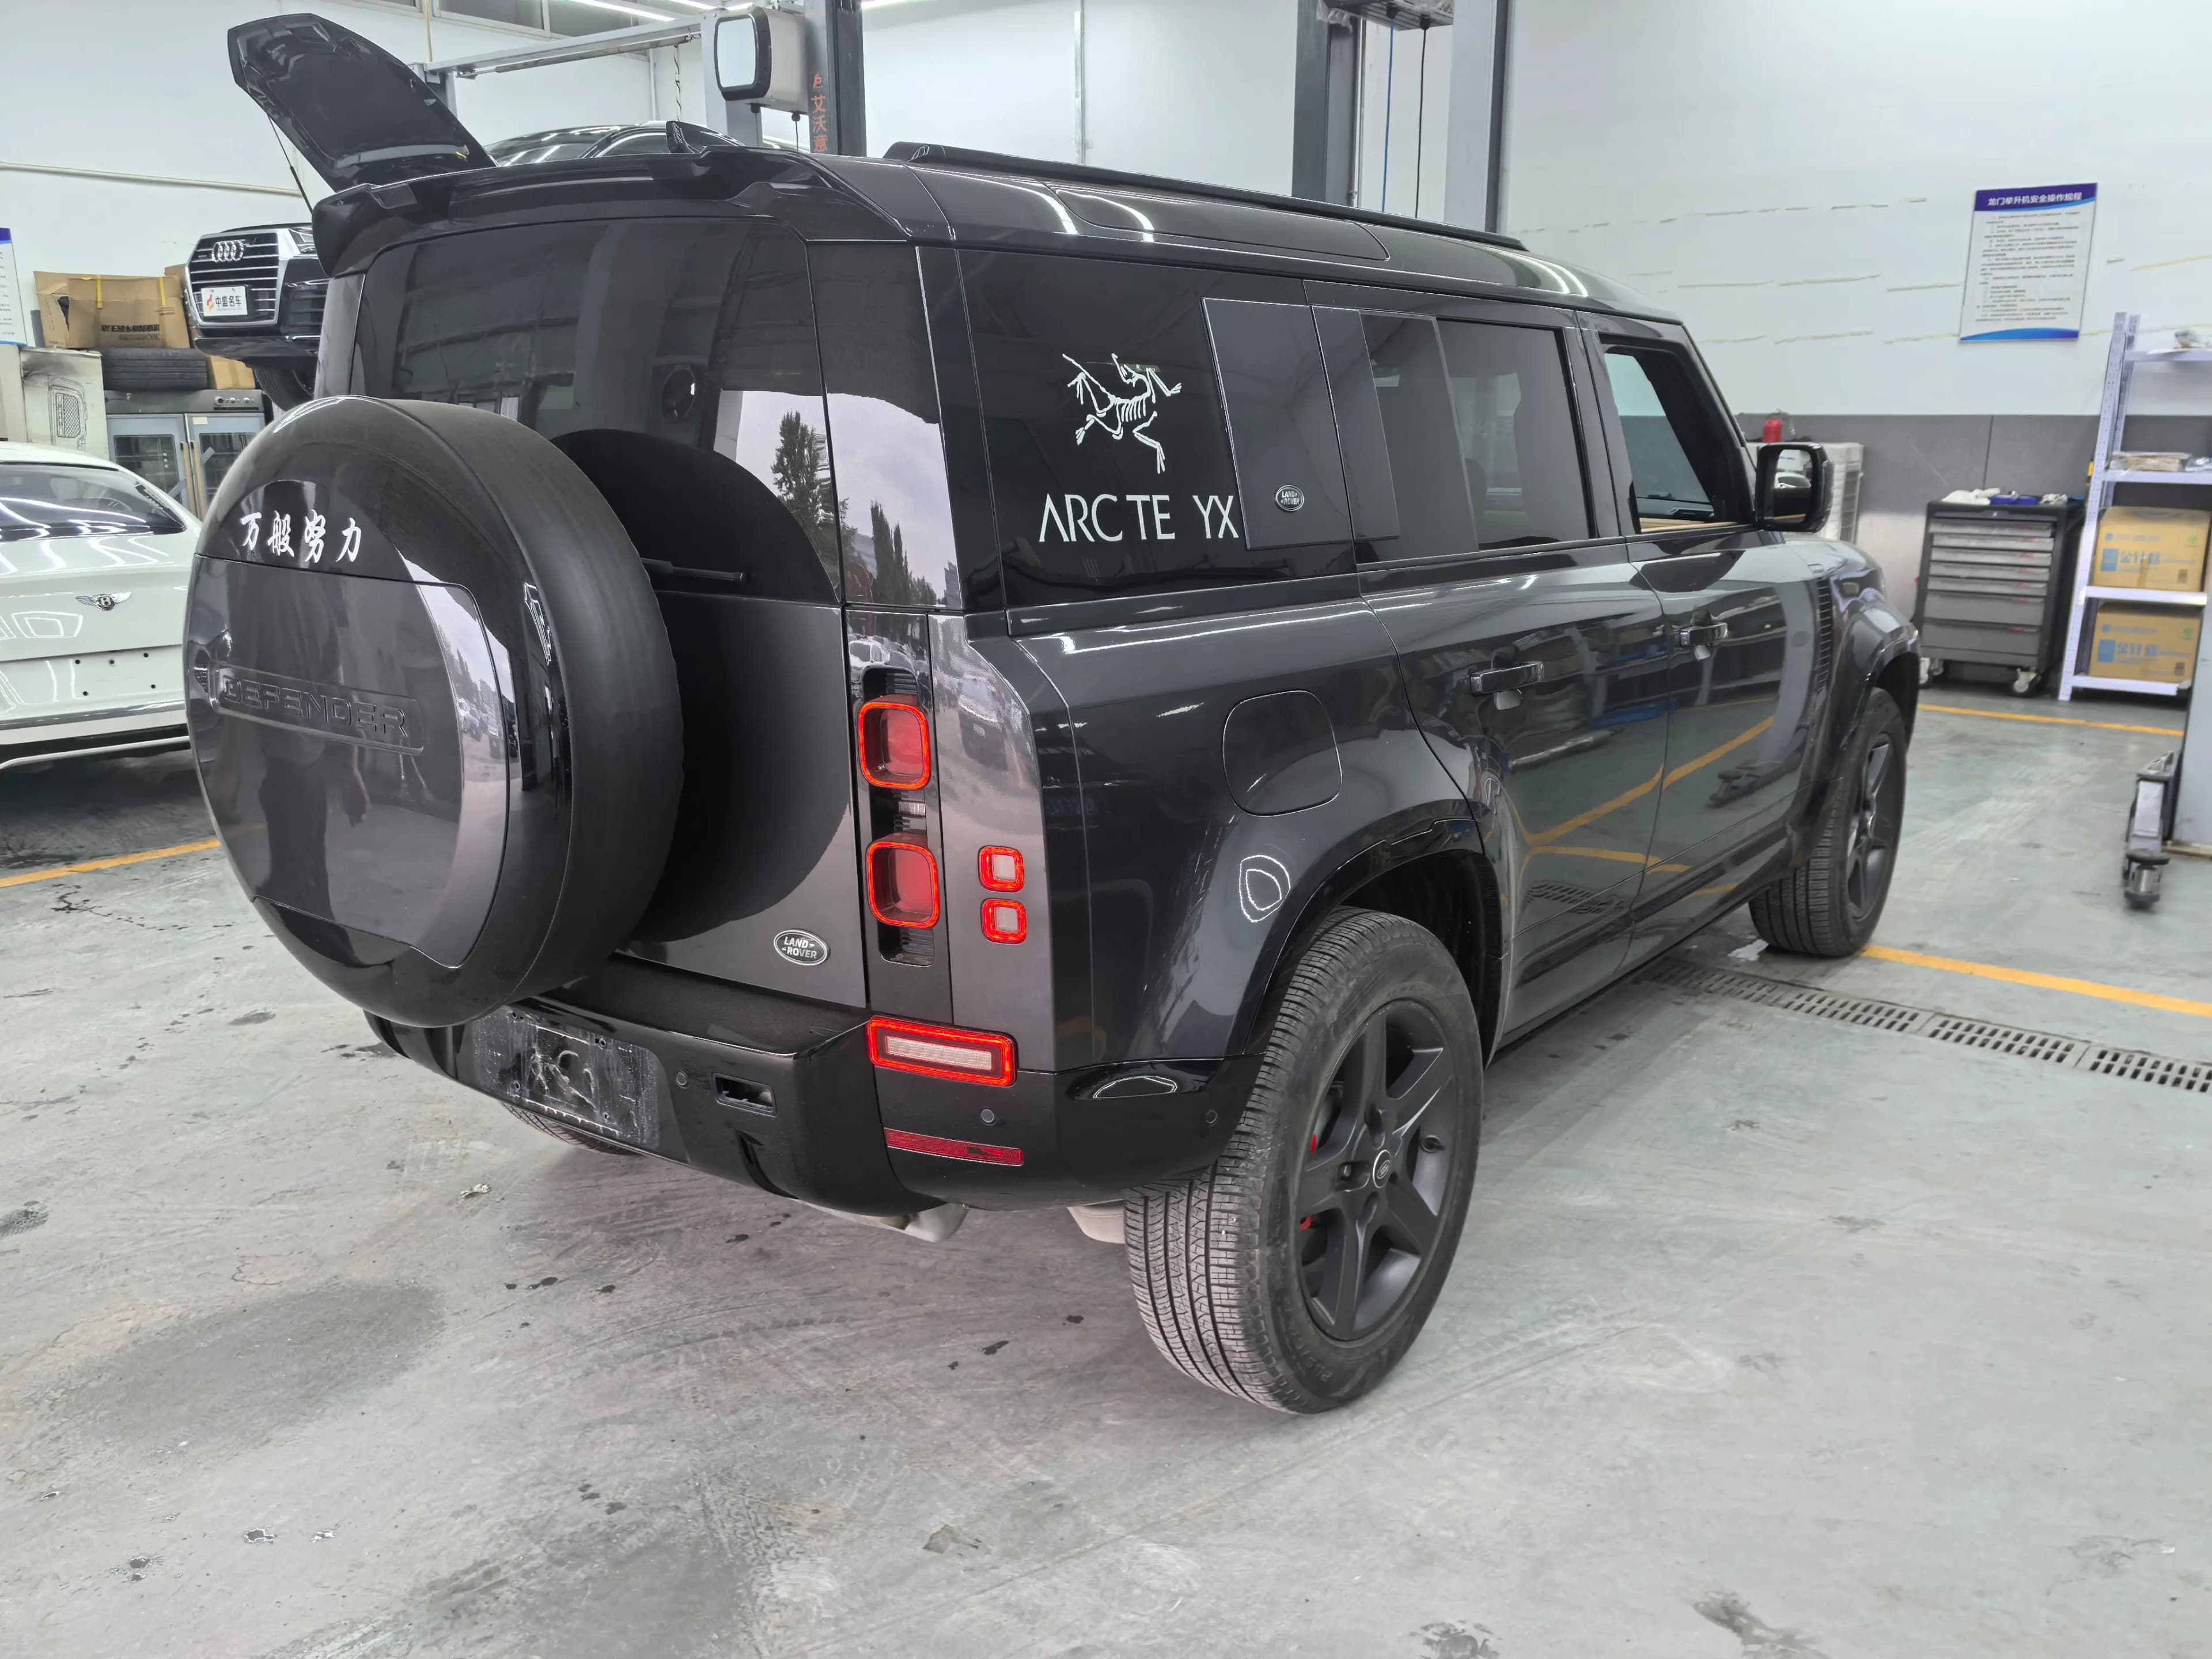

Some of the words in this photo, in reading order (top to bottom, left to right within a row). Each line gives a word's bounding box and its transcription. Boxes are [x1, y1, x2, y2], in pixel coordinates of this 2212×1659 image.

[1988, 192, 2082, 206] 龙门举升机安全操作规程
[215, 296, 242, 308] 中盛名车
[240, 509, 362, 563] 万般努力
[222, 675, 409, 738] DEFENDER
[783, 936, 809, 948] LAND
[786, 946, 817, 959] ROVER
